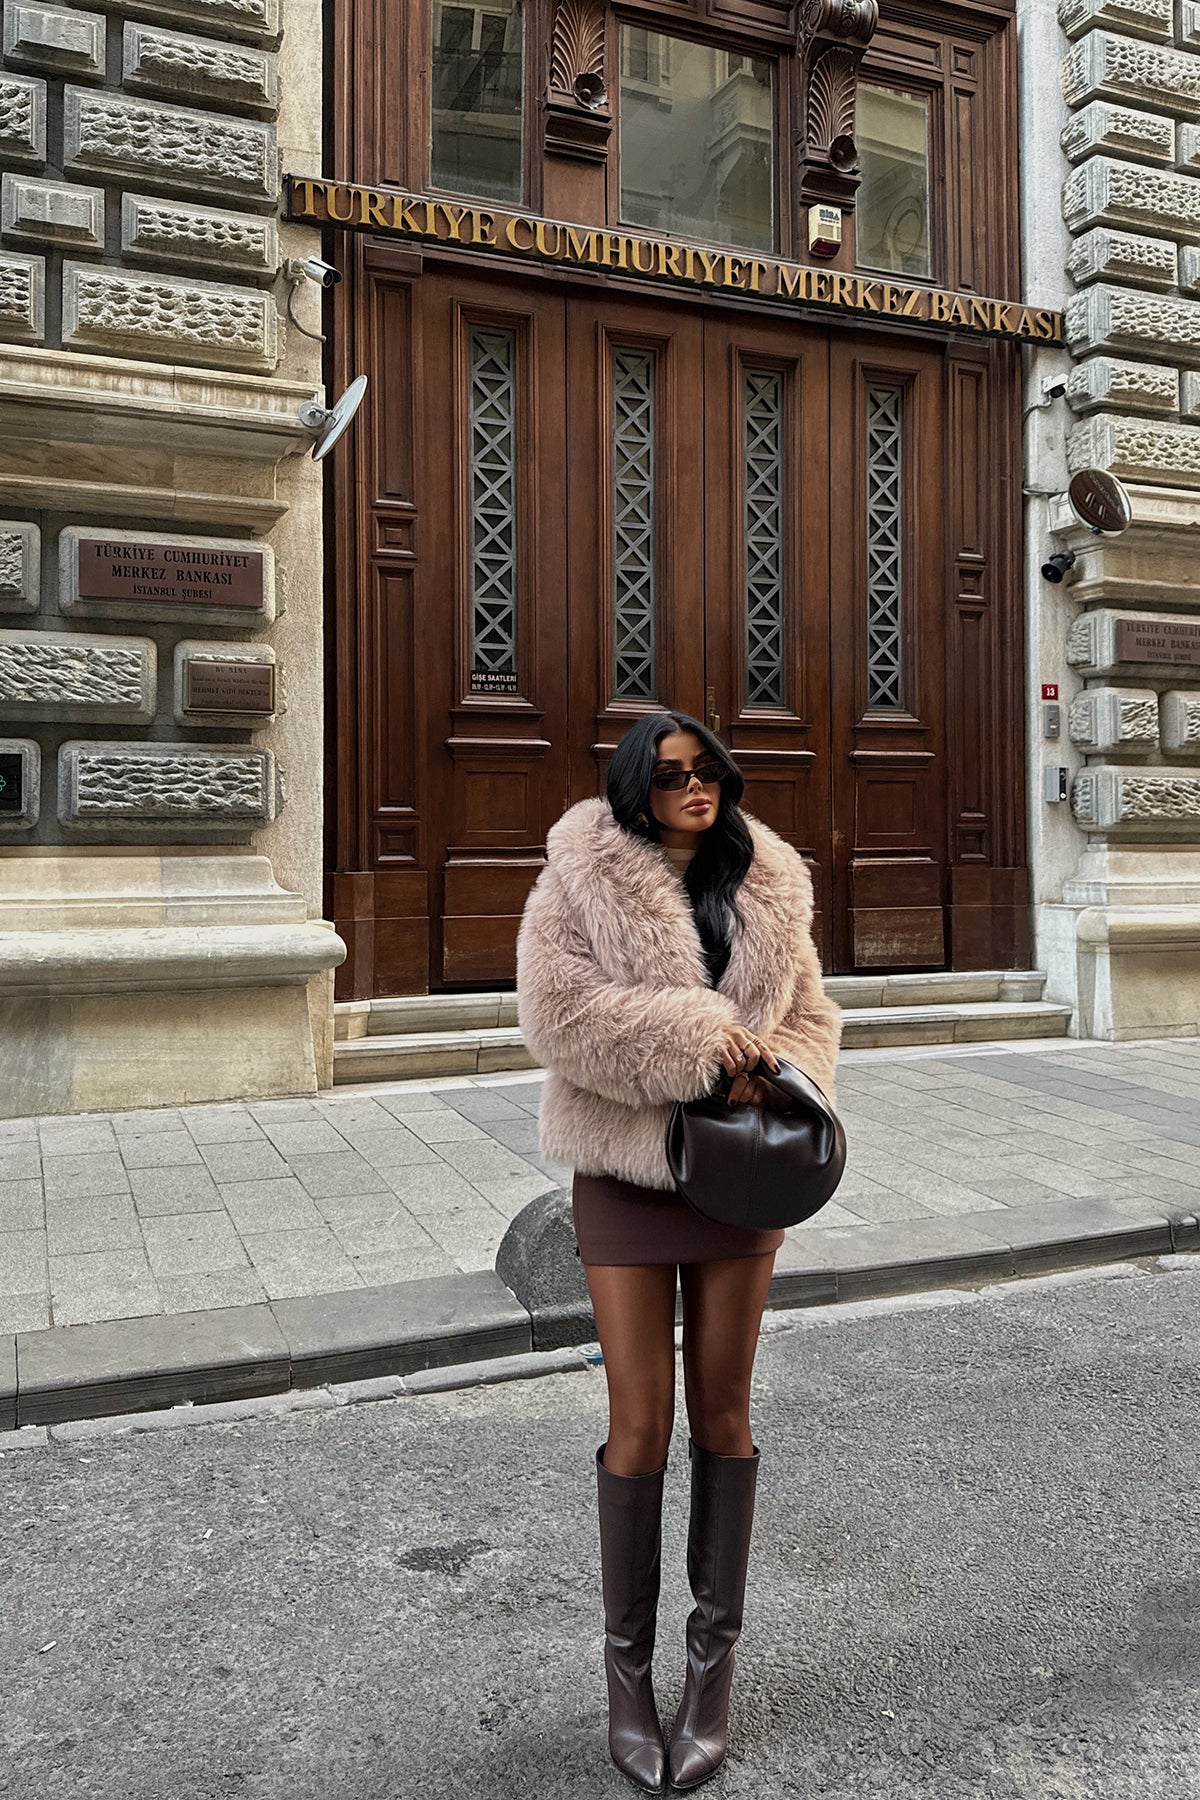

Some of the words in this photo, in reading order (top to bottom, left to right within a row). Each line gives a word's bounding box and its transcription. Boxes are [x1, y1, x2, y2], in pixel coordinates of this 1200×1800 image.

[775, 264, 923, 318] MERKEZ
[929, 291, 1063, 341] BANKASI
[95, 543, 155, 561] TÜRKİYE
[163, 549, 249, 568] CUMHURİYET
[112, 564, 167, 580] MERKEZ
[176, 569, 233, 586] BANKASI
[132, 583, 177, 597] İSTANBUL
[181, 588, 212, 600] ŞUBESİ
[1046, 687, 1056, 697] 13
